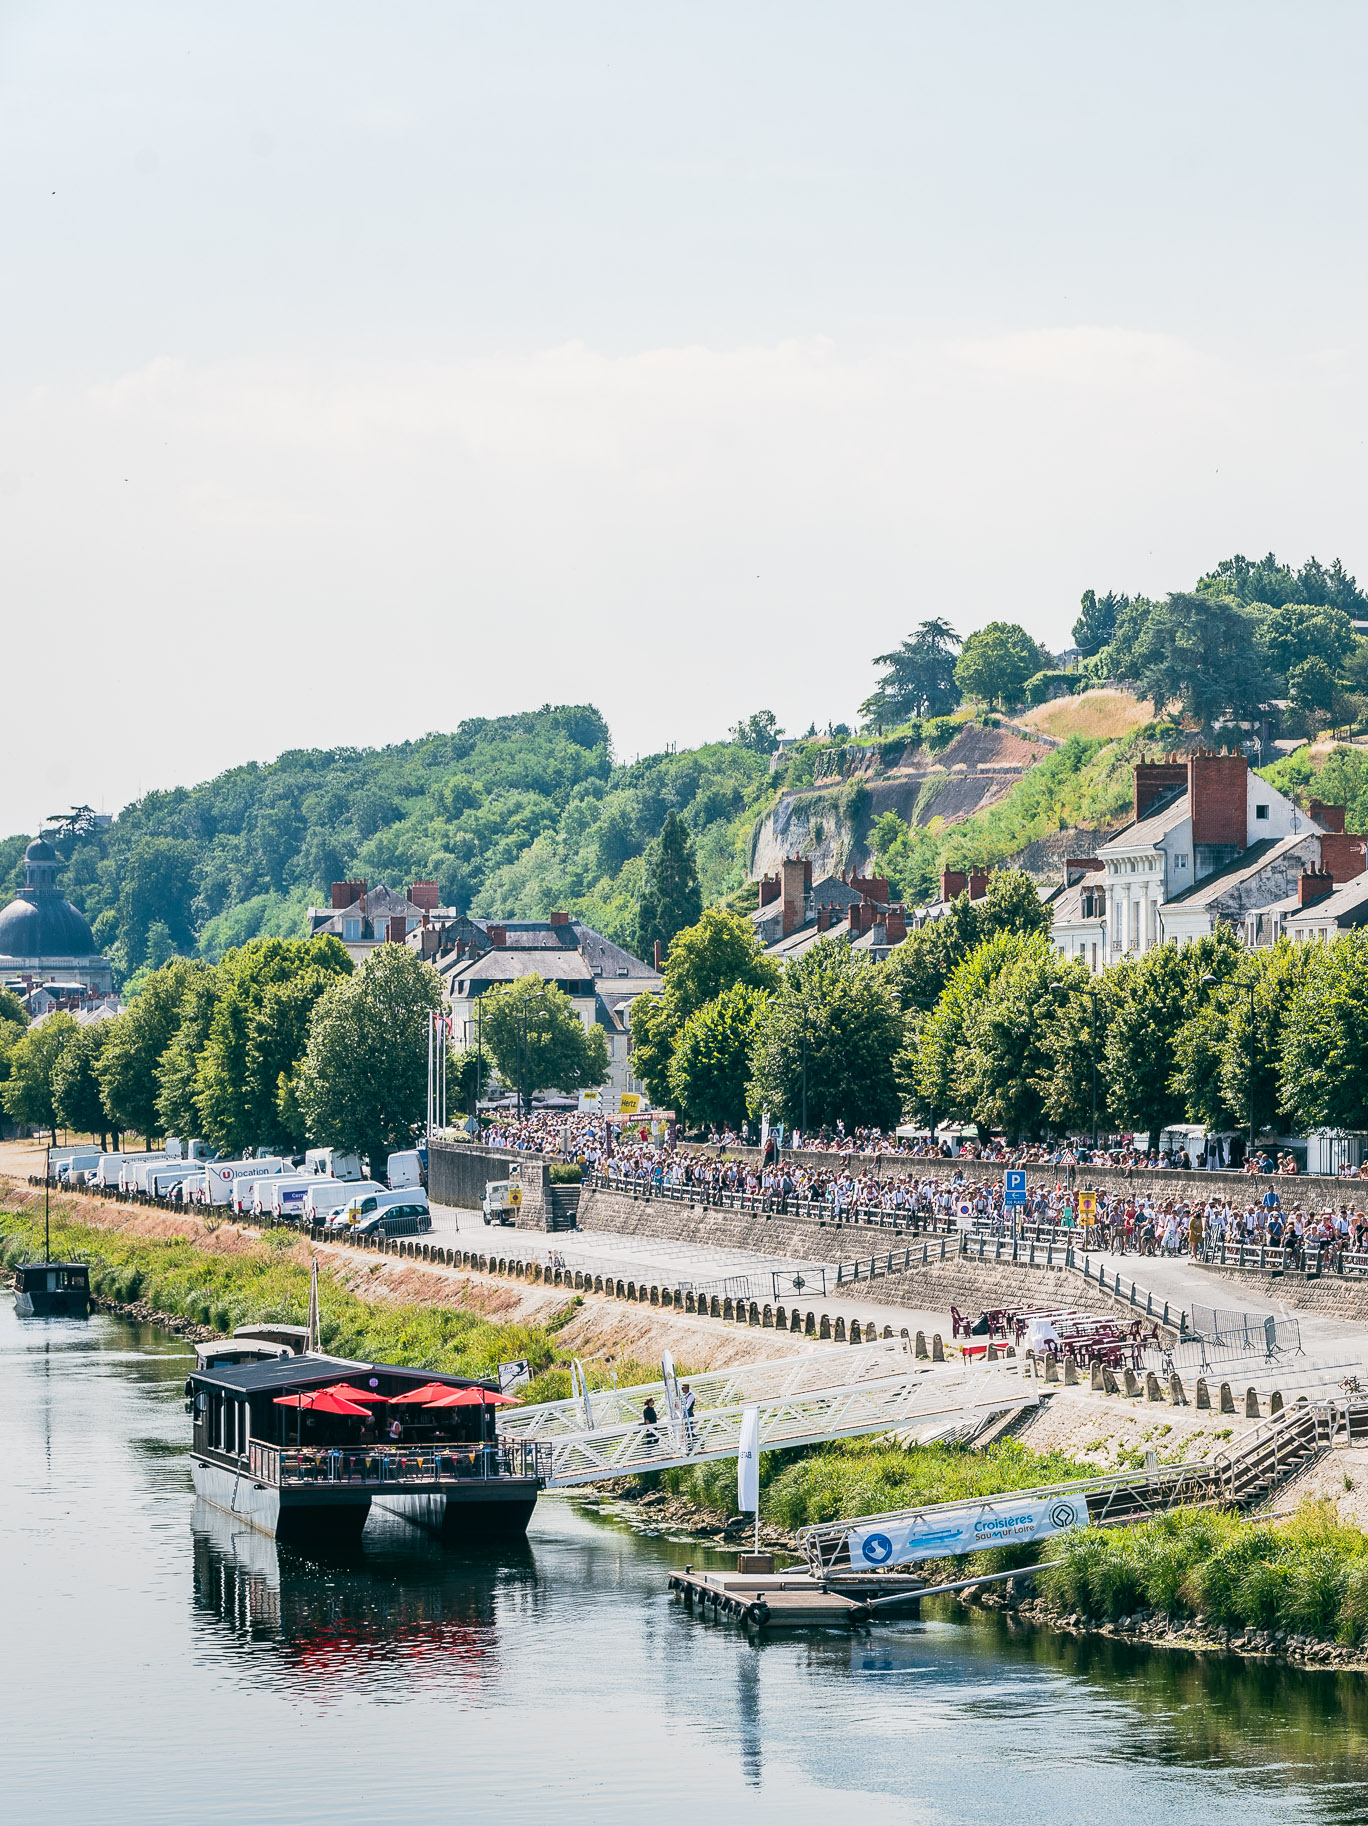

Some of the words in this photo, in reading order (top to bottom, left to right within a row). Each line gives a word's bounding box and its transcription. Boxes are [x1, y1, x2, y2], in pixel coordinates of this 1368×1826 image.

[621, 1099, 636, 1107] Hertz
[235, 1168, 269, 1177] location
[1012, 1174, 1020, 1188] P
[974, 1514, 1033, 1533] Croisières
[975, 1528, 1012, 1541] Saumur
[1013, 1525, 1035, 1535] Loire
